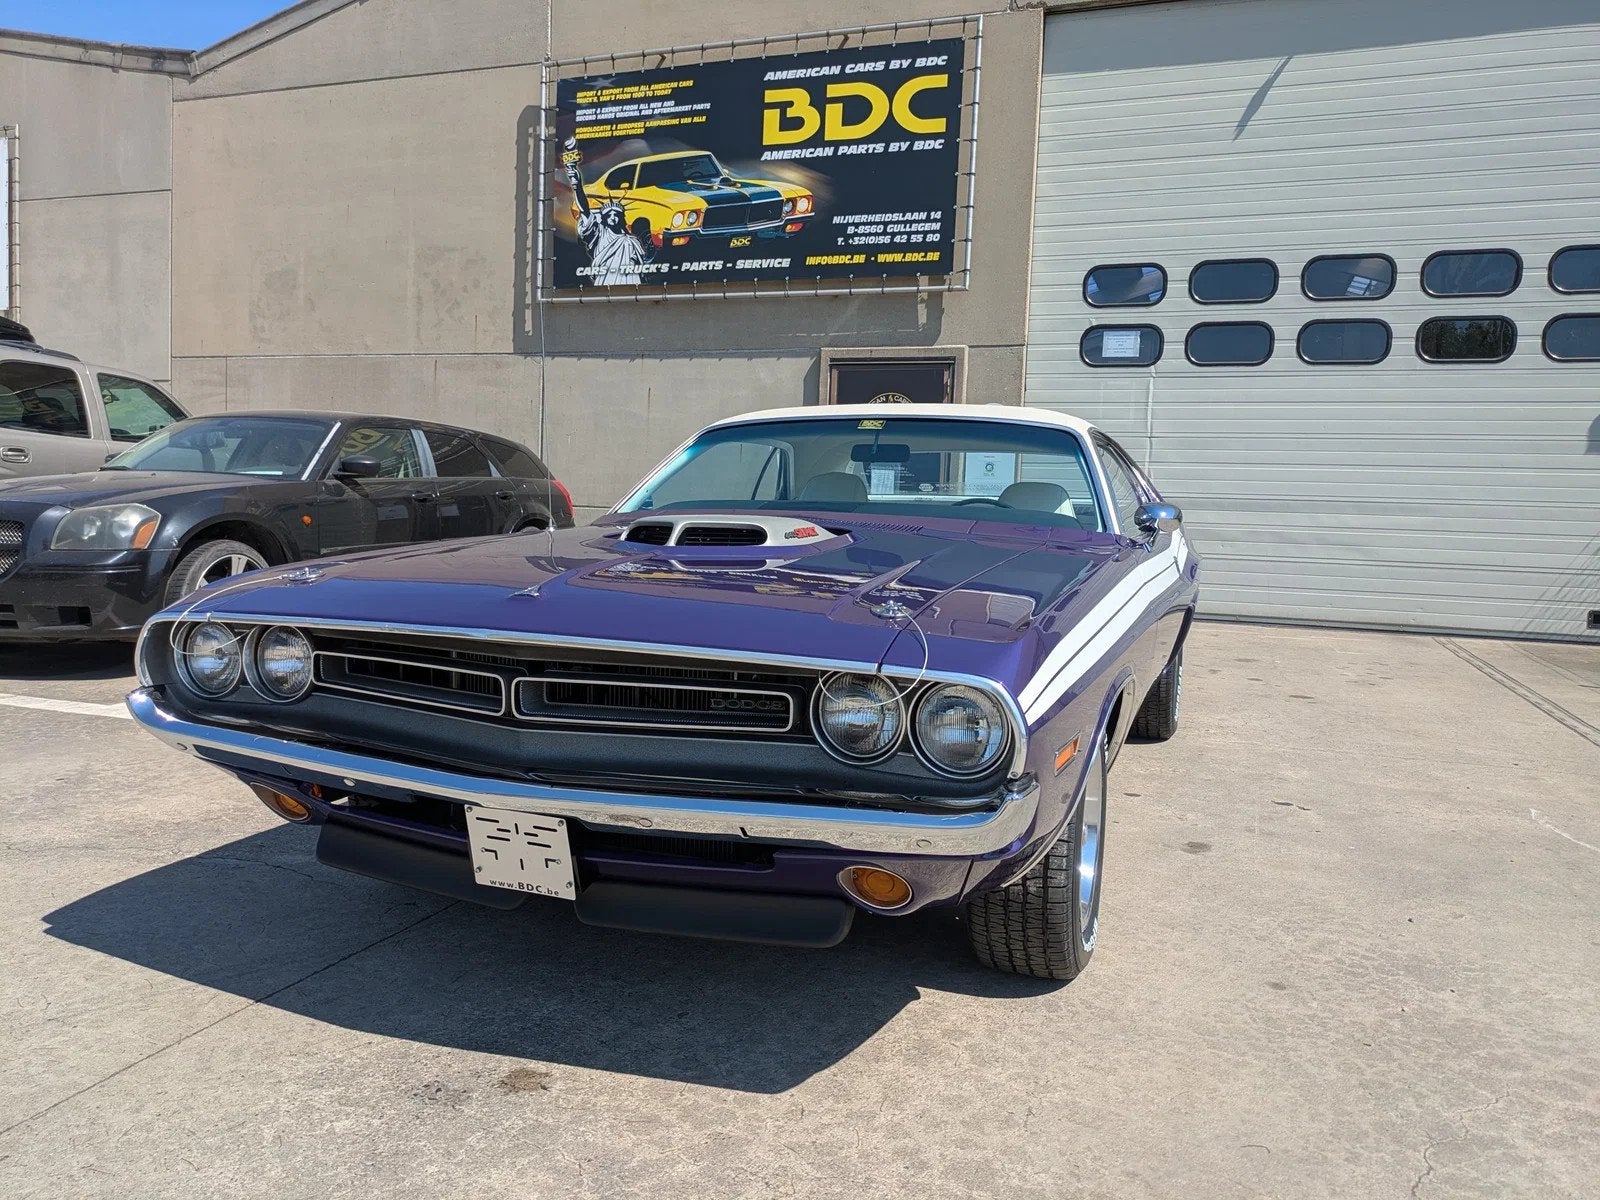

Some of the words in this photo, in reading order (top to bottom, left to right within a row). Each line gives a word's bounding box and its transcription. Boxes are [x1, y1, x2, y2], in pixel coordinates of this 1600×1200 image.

[764, 65, 842, 81] AMERICAN
[844, 60, 886, 74] CARS
[889, 58, 911, 70] BY
[914, 55, 948, 68] BDC
[576, 90, 597, 98] IMPORT
[602, 87, 623, 96] EXPORT
[650, 81, 679, 90] AMERICAN
[678, 79, 694, 87] CARS
[653, 88, 673, 96] TODAY
[575, 108, 597, 116] IMPORT
[601, 105, 623, 114] EXPORT
[649, 101, 663, 109] NEW
[662, 100, 676, 108] AND
[640, 108, 653, 116] AND
[692, 102, 711, 110] PARTS
[762, 73, 949, 146] BDC
[692, 115, 707, 123] ALLE
[760, 147, 836, 162] AMERICAN
[837, 142, 886, 156] PARTS
[888, 141, 910, 152] BY
[912, 138, 945, 151] BDC
[832, 212, 927, 224] NIJVERHEIDSLAAN
[929, 211, 942, 220] 14
[846, 225, 884, 234] B-8560
[886, 222, 941, 233] GULLEGEM
[729, 237, 752, 247] BDC
[837, 237, 845, 246] T.
[848, 235, 892, 245] +32(0)56
[893, 234, 908, 243] 42
[910, 234, 923, 243] 55
[925, 233, 940, 242] 80
[805, 254, 866, 265] INFO@BDC.BE
[877, 252, 941, 263] WWW.BDC.BE
[575, 266, 606, 277] CARS
[619, 262, 670, 275] TRUCK'S
[681, 260, 724, 272] PARTS
[735, 258, 792, 269] SERVICE
[710, 698, 786, 711] DODGE
[489, 879, 560, 897] www.BDC.be
